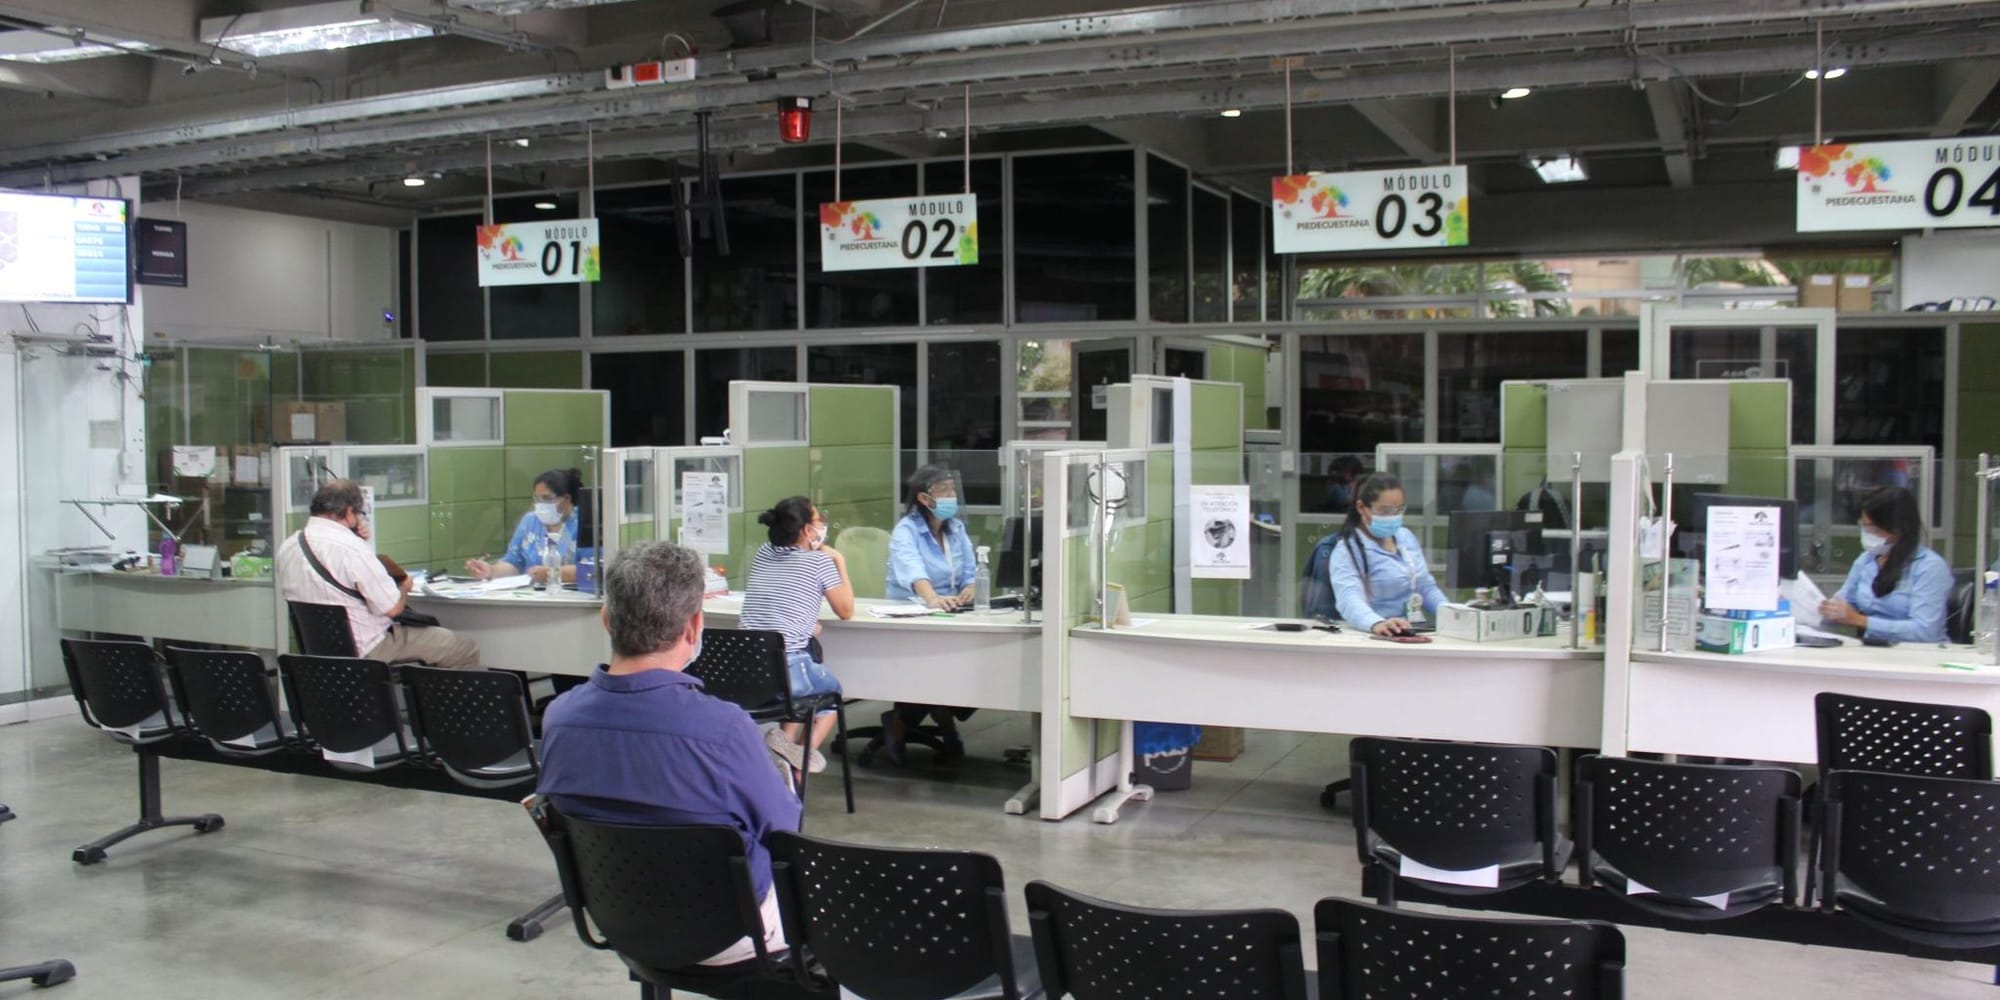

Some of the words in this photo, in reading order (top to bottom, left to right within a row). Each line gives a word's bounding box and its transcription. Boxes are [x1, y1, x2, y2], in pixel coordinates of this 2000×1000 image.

[1936, 144, 2000, 164] MÓDU
[1384, 173, 1452, 192] MÓDULO
[909, 200, 963, 217] MÓDULO
[1825, 193, 1917, 207] PIEDECUESTANA
[1296, 218, 1370, 231] PIEDECUESTANA
[1376, 192, 1443, 239] 03
[545, 226, 588, 240] MÓDULO
[901, 218, 955, 260] 02
[840, 240, 898, 251] PIEDECUESTANA
[541, 241, 581, 276] 01
